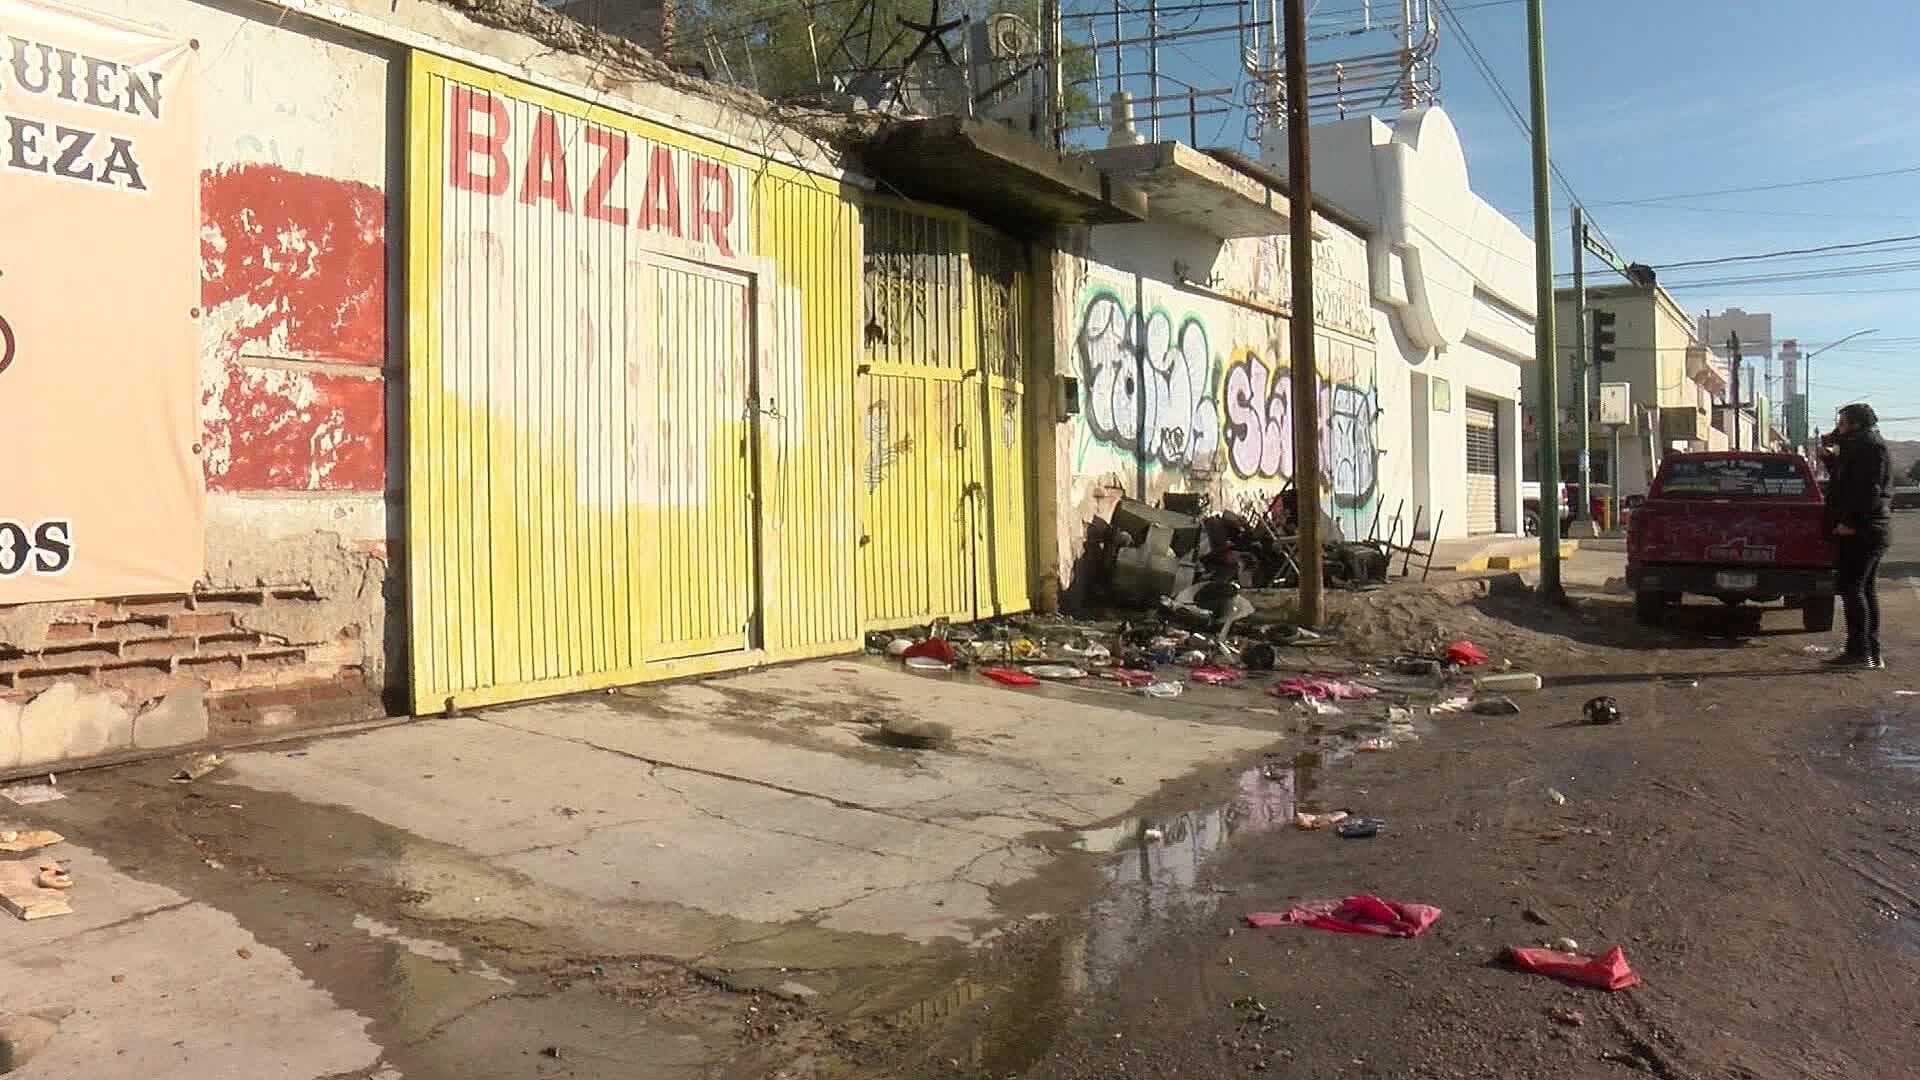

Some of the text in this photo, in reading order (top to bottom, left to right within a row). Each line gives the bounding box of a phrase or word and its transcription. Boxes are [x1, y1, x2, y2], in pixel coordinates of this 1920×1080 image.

[0, 35, 162, 119] UIEN
[0, 115, 147, 190] EZA
[449, 85, 735, 259] BAZAR
